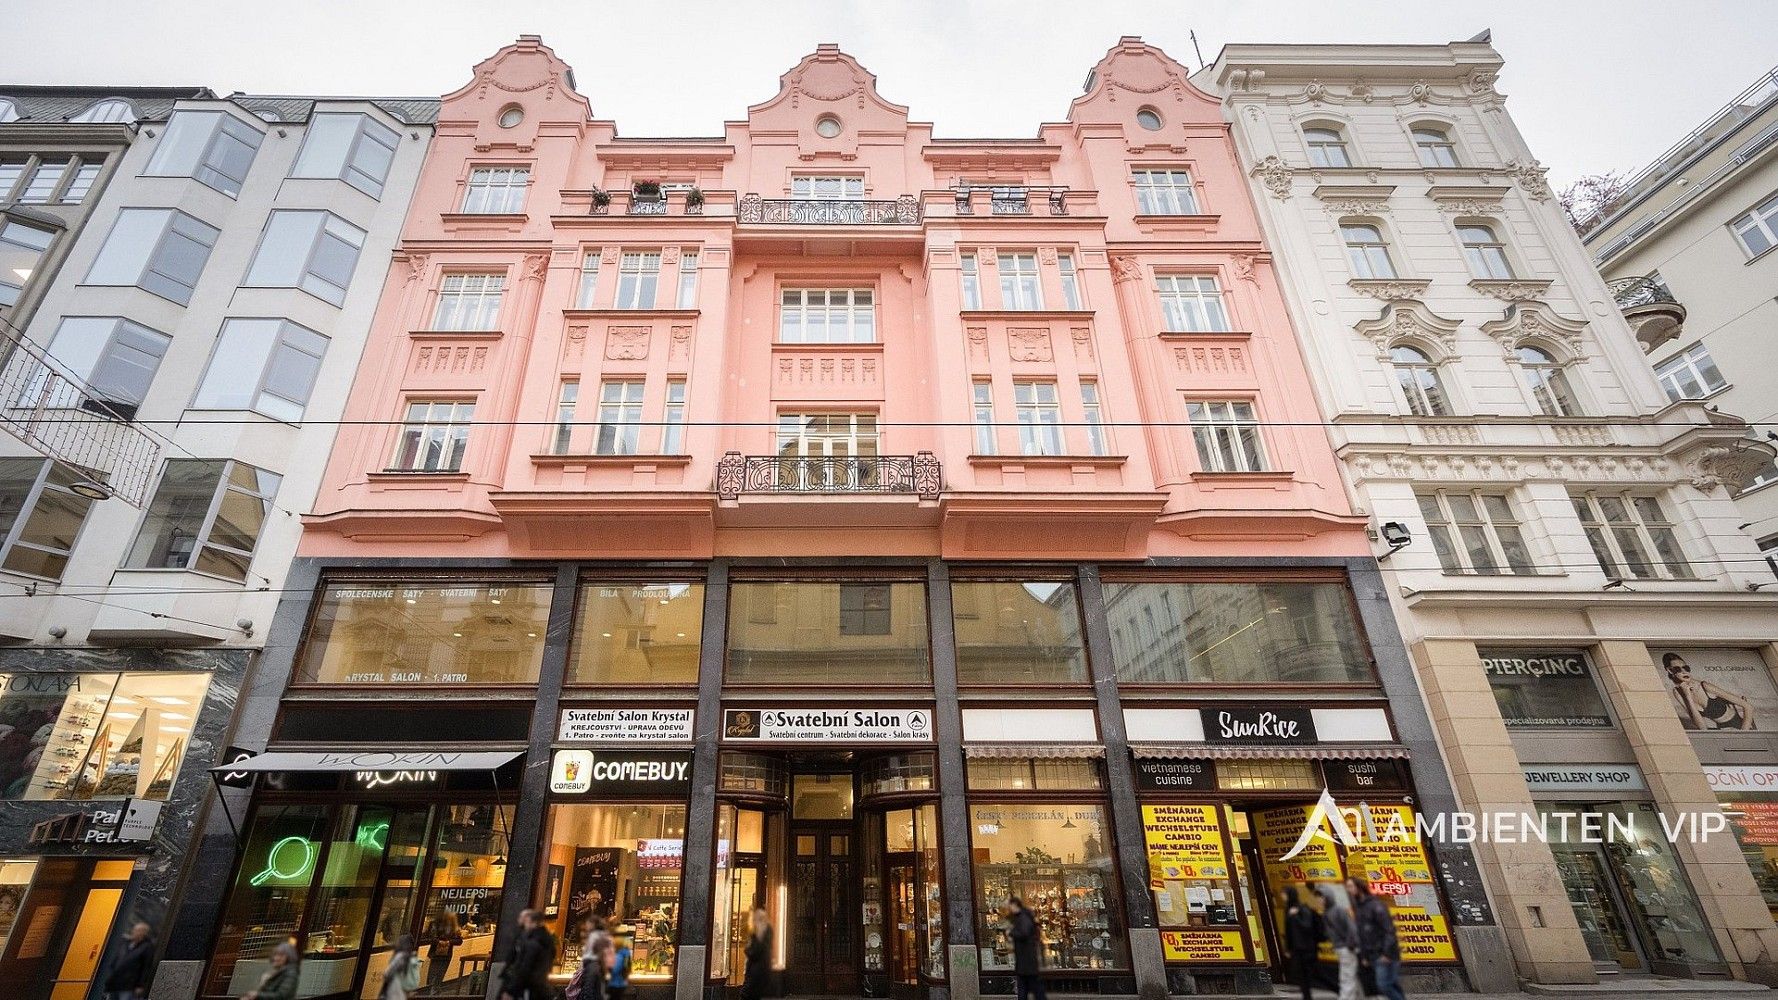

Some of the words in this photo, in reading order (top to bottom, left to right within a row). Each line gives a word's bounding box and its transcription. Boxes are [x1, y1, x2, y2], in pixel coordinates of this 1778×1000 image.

[391, 672, 422, 682] SALON
[441, 673, 468, 682] PATRO
[568, 710, 615, 721] Svatební
[618, 710, 648, 721] Salon
[651, 710, 690, 724] Krystal
[776, 711, 849, 728] Svatební
[854, 711, 901, 728] Salon
[1218, 711, 1300, 739] SunRice
[639, 732, 667, 740] krystal
[769, 730, 796, 739] Svatební
[797, 731, 824, 739] centrum
[829, 730, 857, 739] Svatební
[858, 730, 887, 739] dekorace
[893, 730, 911, 739] Salon
[317, 753, 462, 766] WOKIN
[1141, 762, 1202, 774] vietnamese
[1348, 762, 1377, 774] sushi
[1155, 774, 1193, 786] cuisine
[1357, 774, 1374, 786] bar
[1525, 772, 1593, 783] JEWELLERY
[1595, 772, 1631, 783] SHOP
[1153, 806, 1204, 815] SMĚNÁRNA
[1155, 815, 1206, 823] EXCHANGE
[1145, 824, 1219, 832] WECHSELSTUBE
[1164, 833, 1202, 841] CAMBIO
[1181, 931, 1223, 939] SMĚNÁRNA
